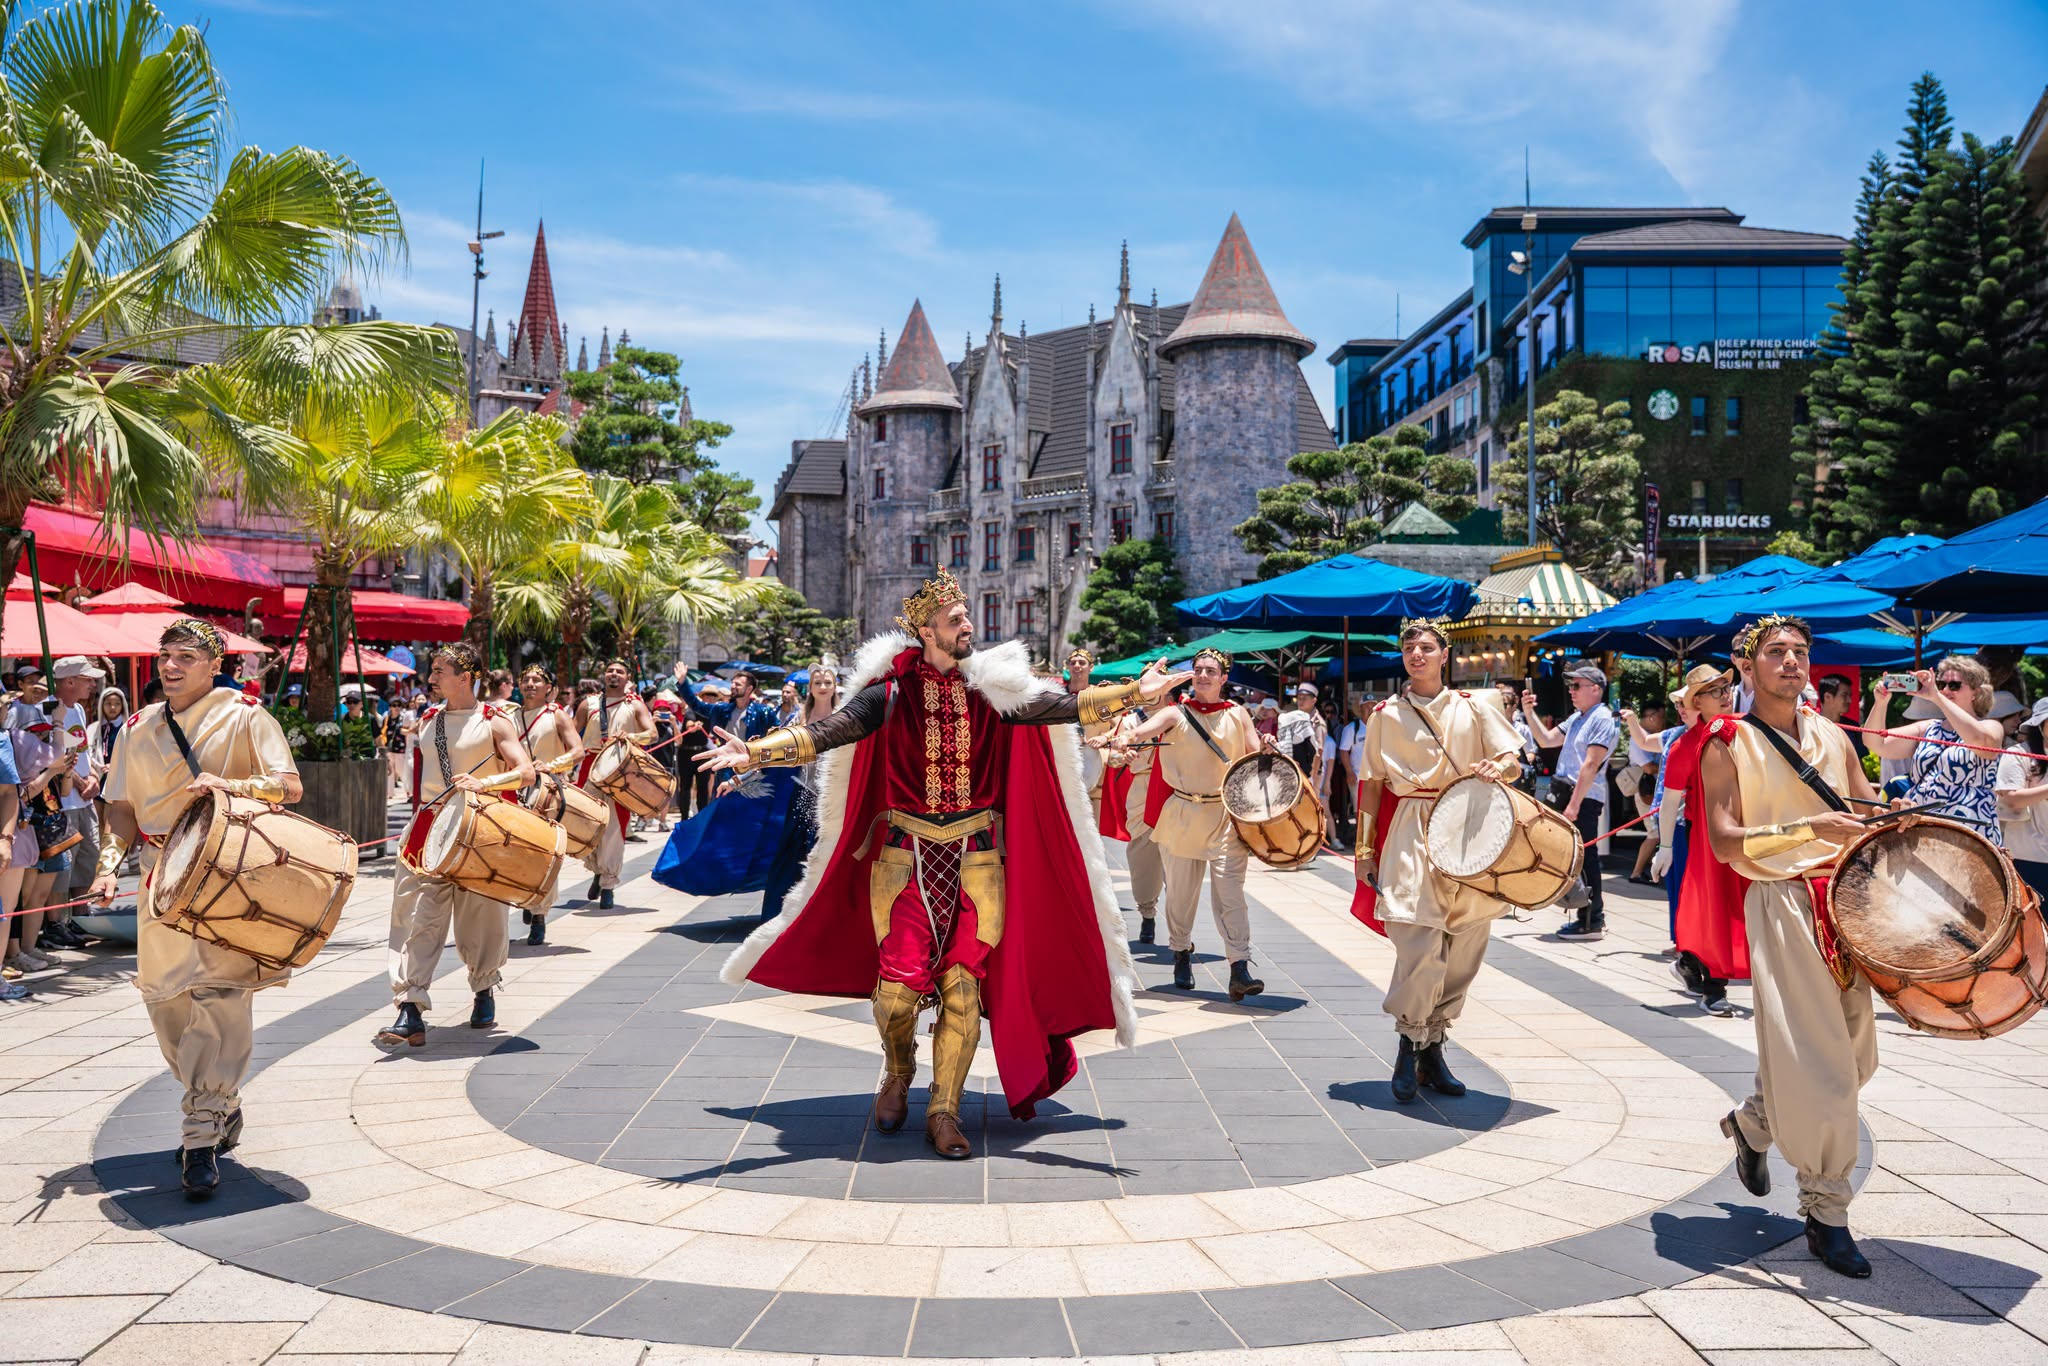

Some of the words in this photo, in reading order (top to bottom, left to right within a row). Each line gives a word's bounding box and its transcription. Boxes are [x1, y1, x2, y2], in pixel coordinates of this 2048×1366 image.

[1719, 339, 1747, 348] DEEP
[1750, 339, 1782, 348] FRIED
[1784, 339, 1817, 348] CHICK
[1648, 345, 1712, 363] ROSA
[1719, 350, 1739, 359] HOT
[1741, 350, 1762, 359] POT
[1764, 350, 1804, 359] BUFFET
[1719, 360, 1752, 369] SUSHI
[1757, 360, 1780, 369] BAR
[1667, 514, 1771, 528] STARBUCKS
